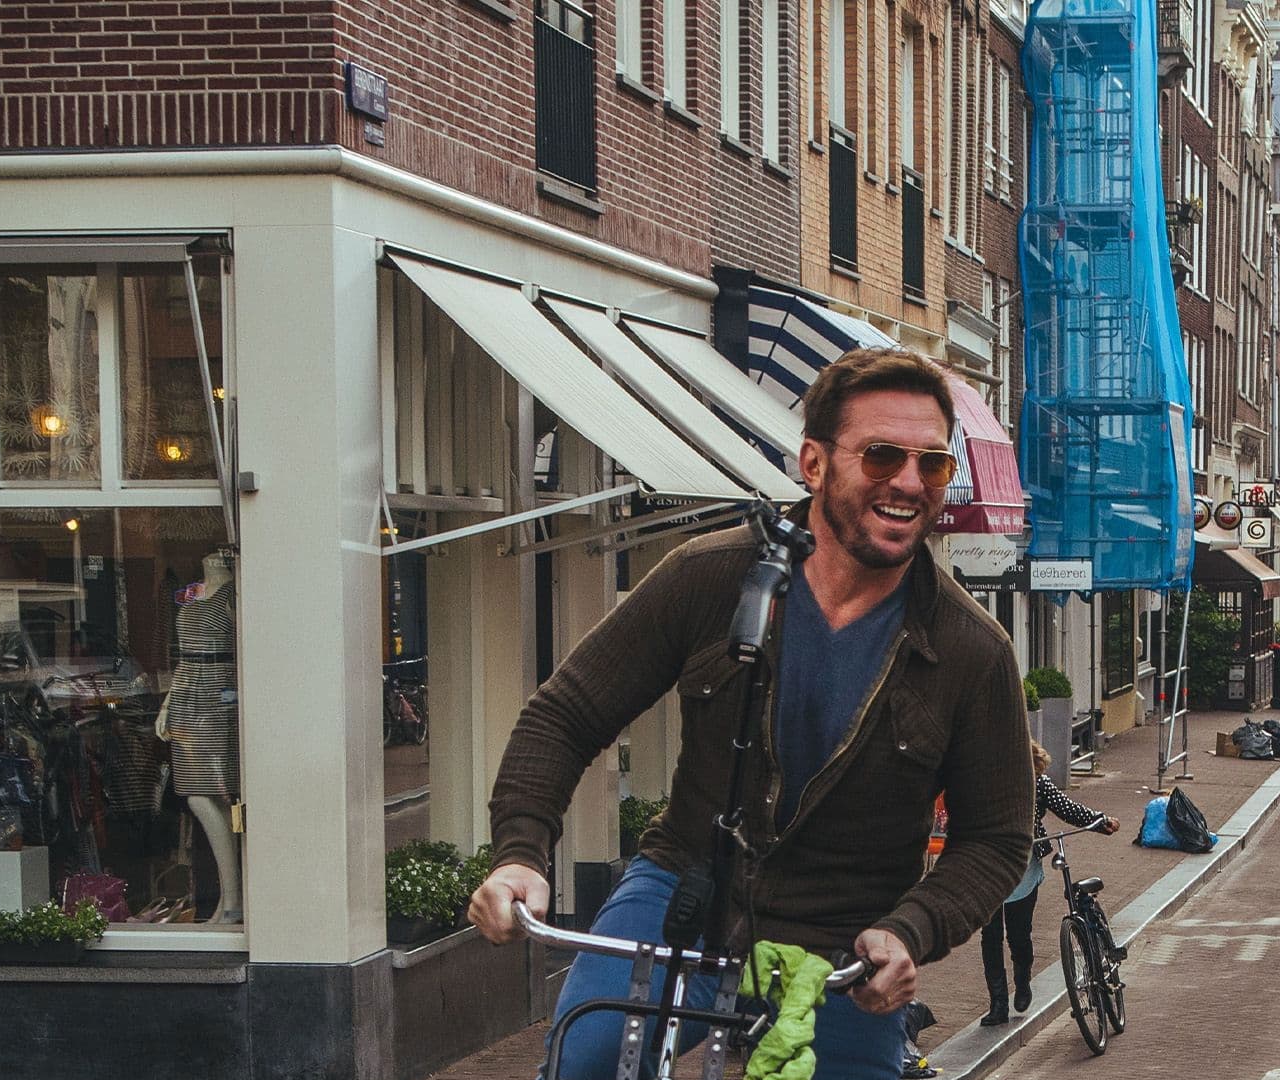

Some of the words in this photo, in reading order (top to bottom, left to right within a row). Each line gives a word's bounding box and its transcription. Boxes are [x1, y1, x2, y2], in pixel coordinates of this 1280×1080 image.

[950, 547, 985, 559] pretty
[988, 547, 1016, 559] rings
[1007, 564, 1024, 572] ore
[1032, 567, 1087, 579] de9heren
